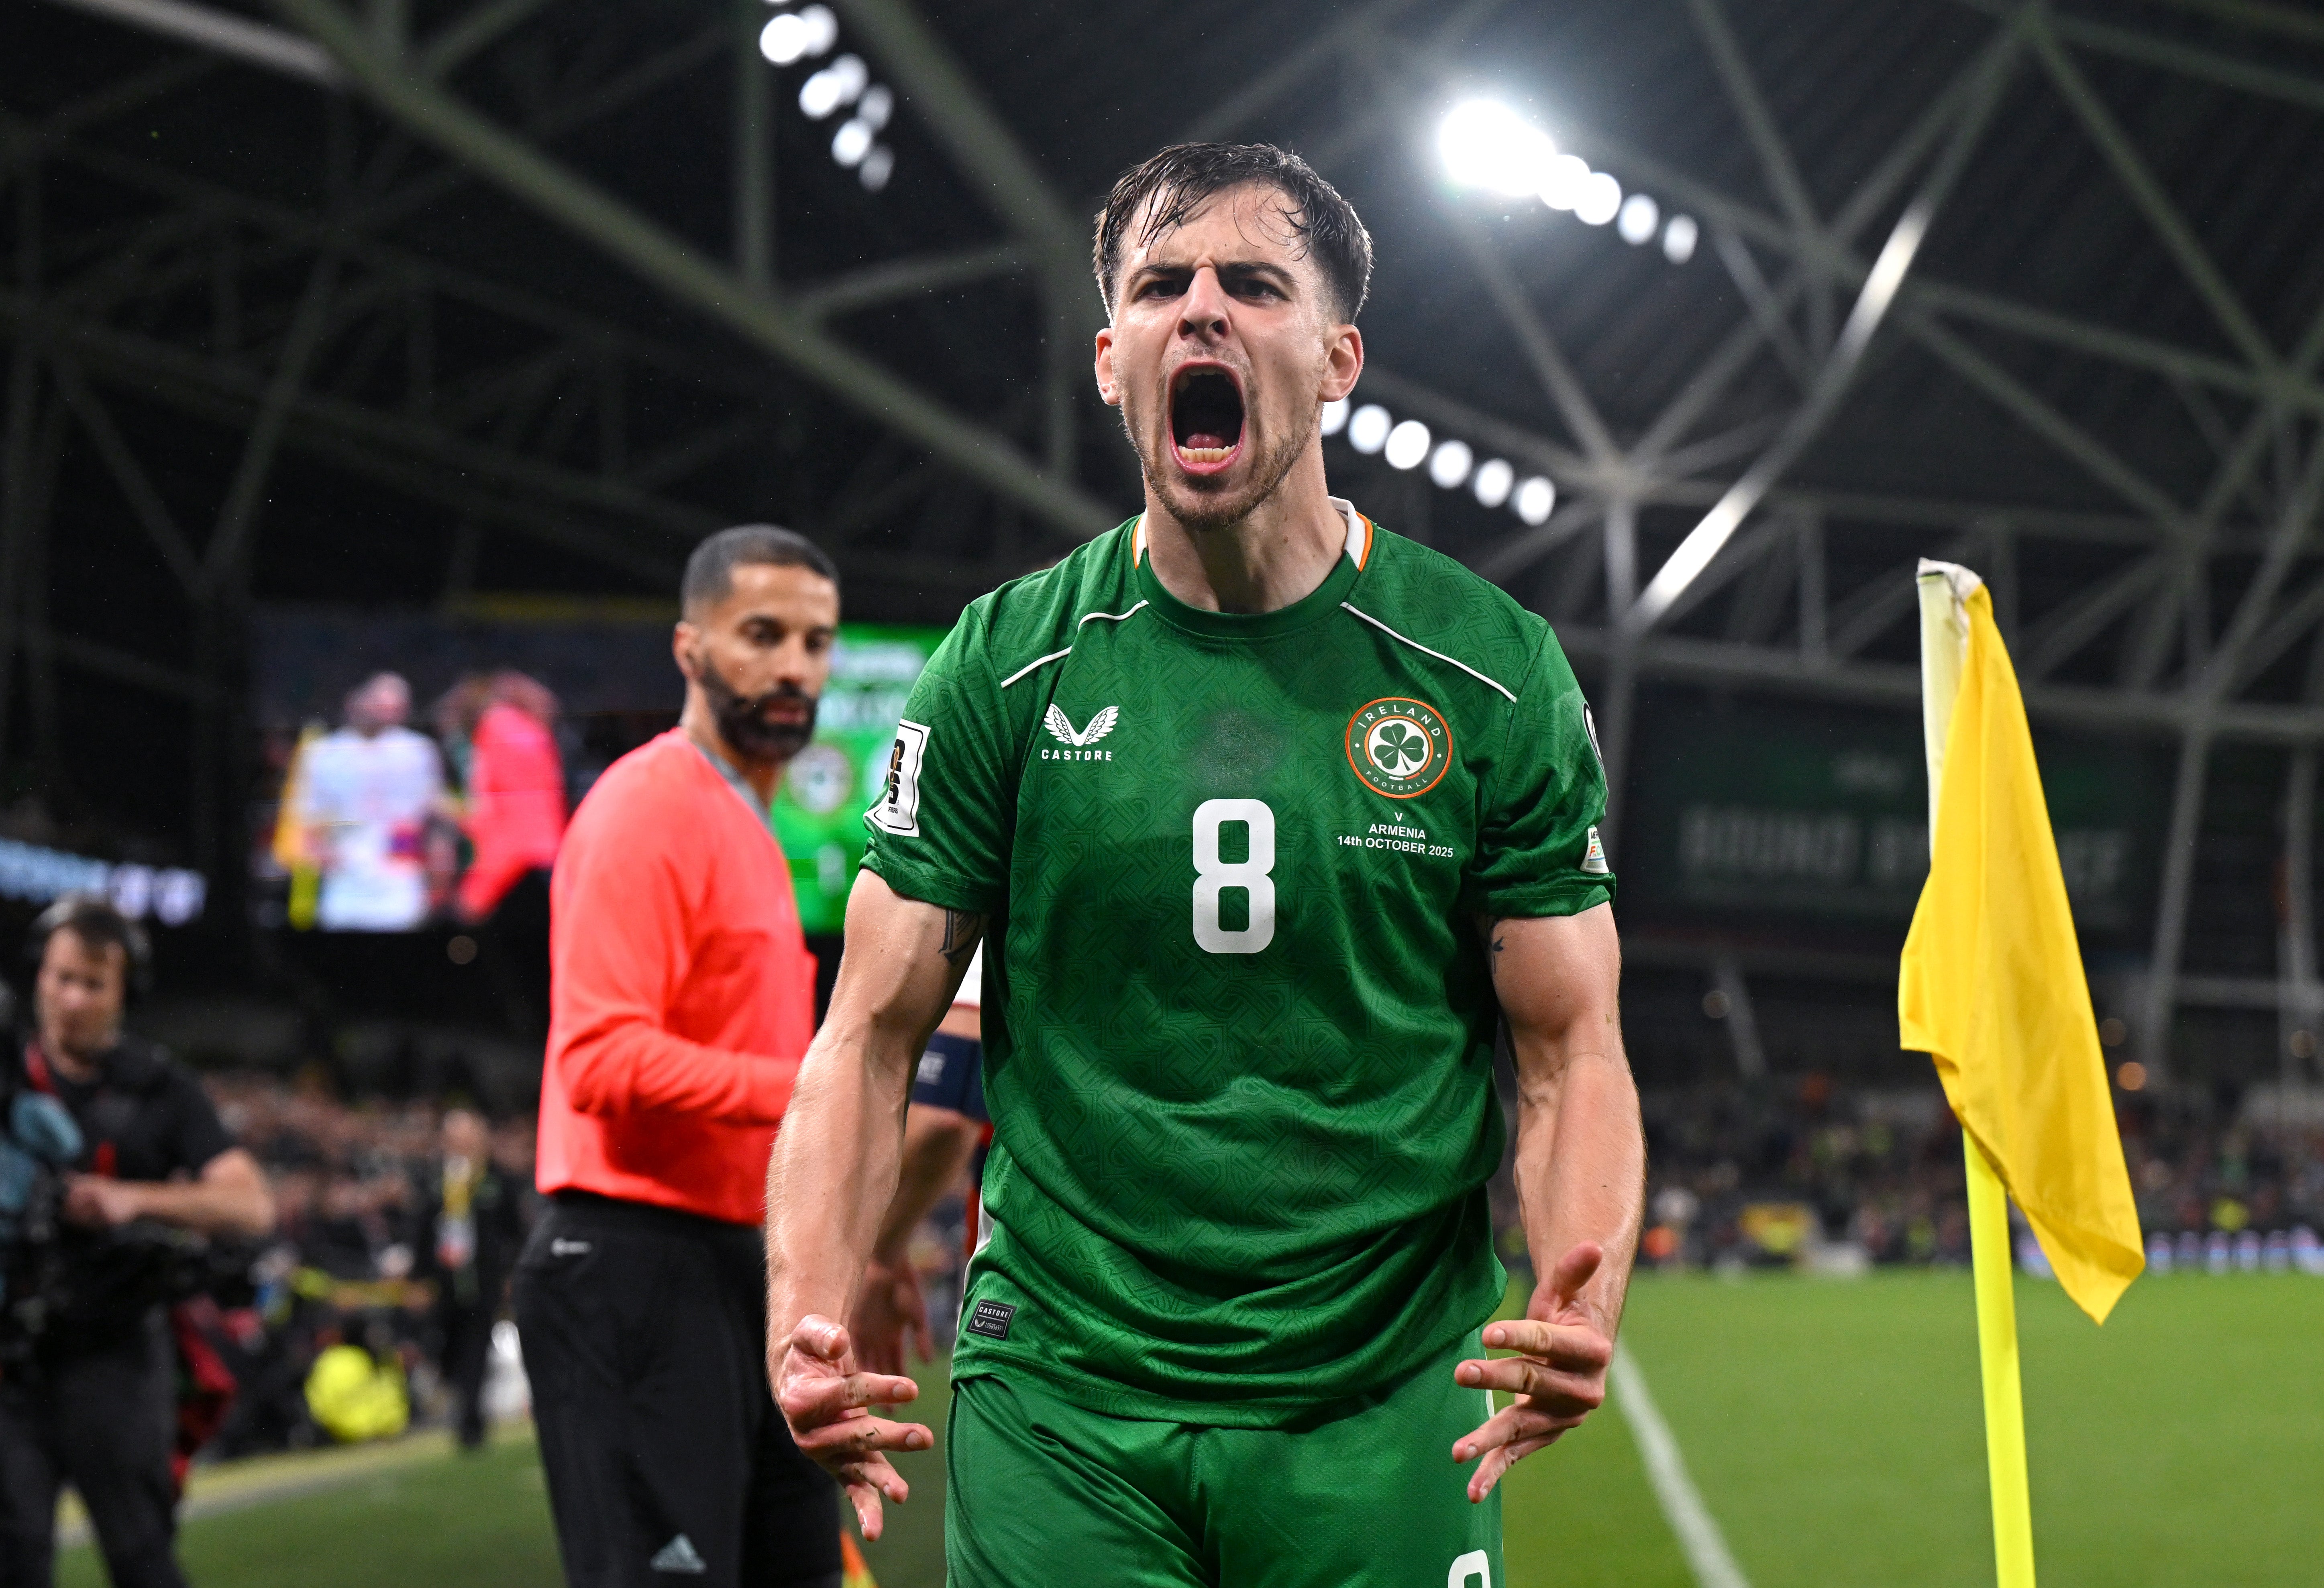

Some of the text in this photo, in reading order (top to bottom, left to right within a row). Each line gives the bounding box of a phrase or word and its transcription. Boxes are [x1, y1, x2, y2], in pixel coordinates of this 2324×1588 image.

[1358, 704, 1441, 736] IRELAND
[1042, 749, 1112, 761] CASTORE
[1366, 770, 1427, 790] FOOTBALL
[1394, 812, 1403, 822] V
[1368, 824, 1426, 839] ARMENIA
[1337, 835, 1454, 857] 14th OCTOBER 2025
[1193, 798, 1275, 954] 8
[979, 1307, 1009, 1318] CASTORE
